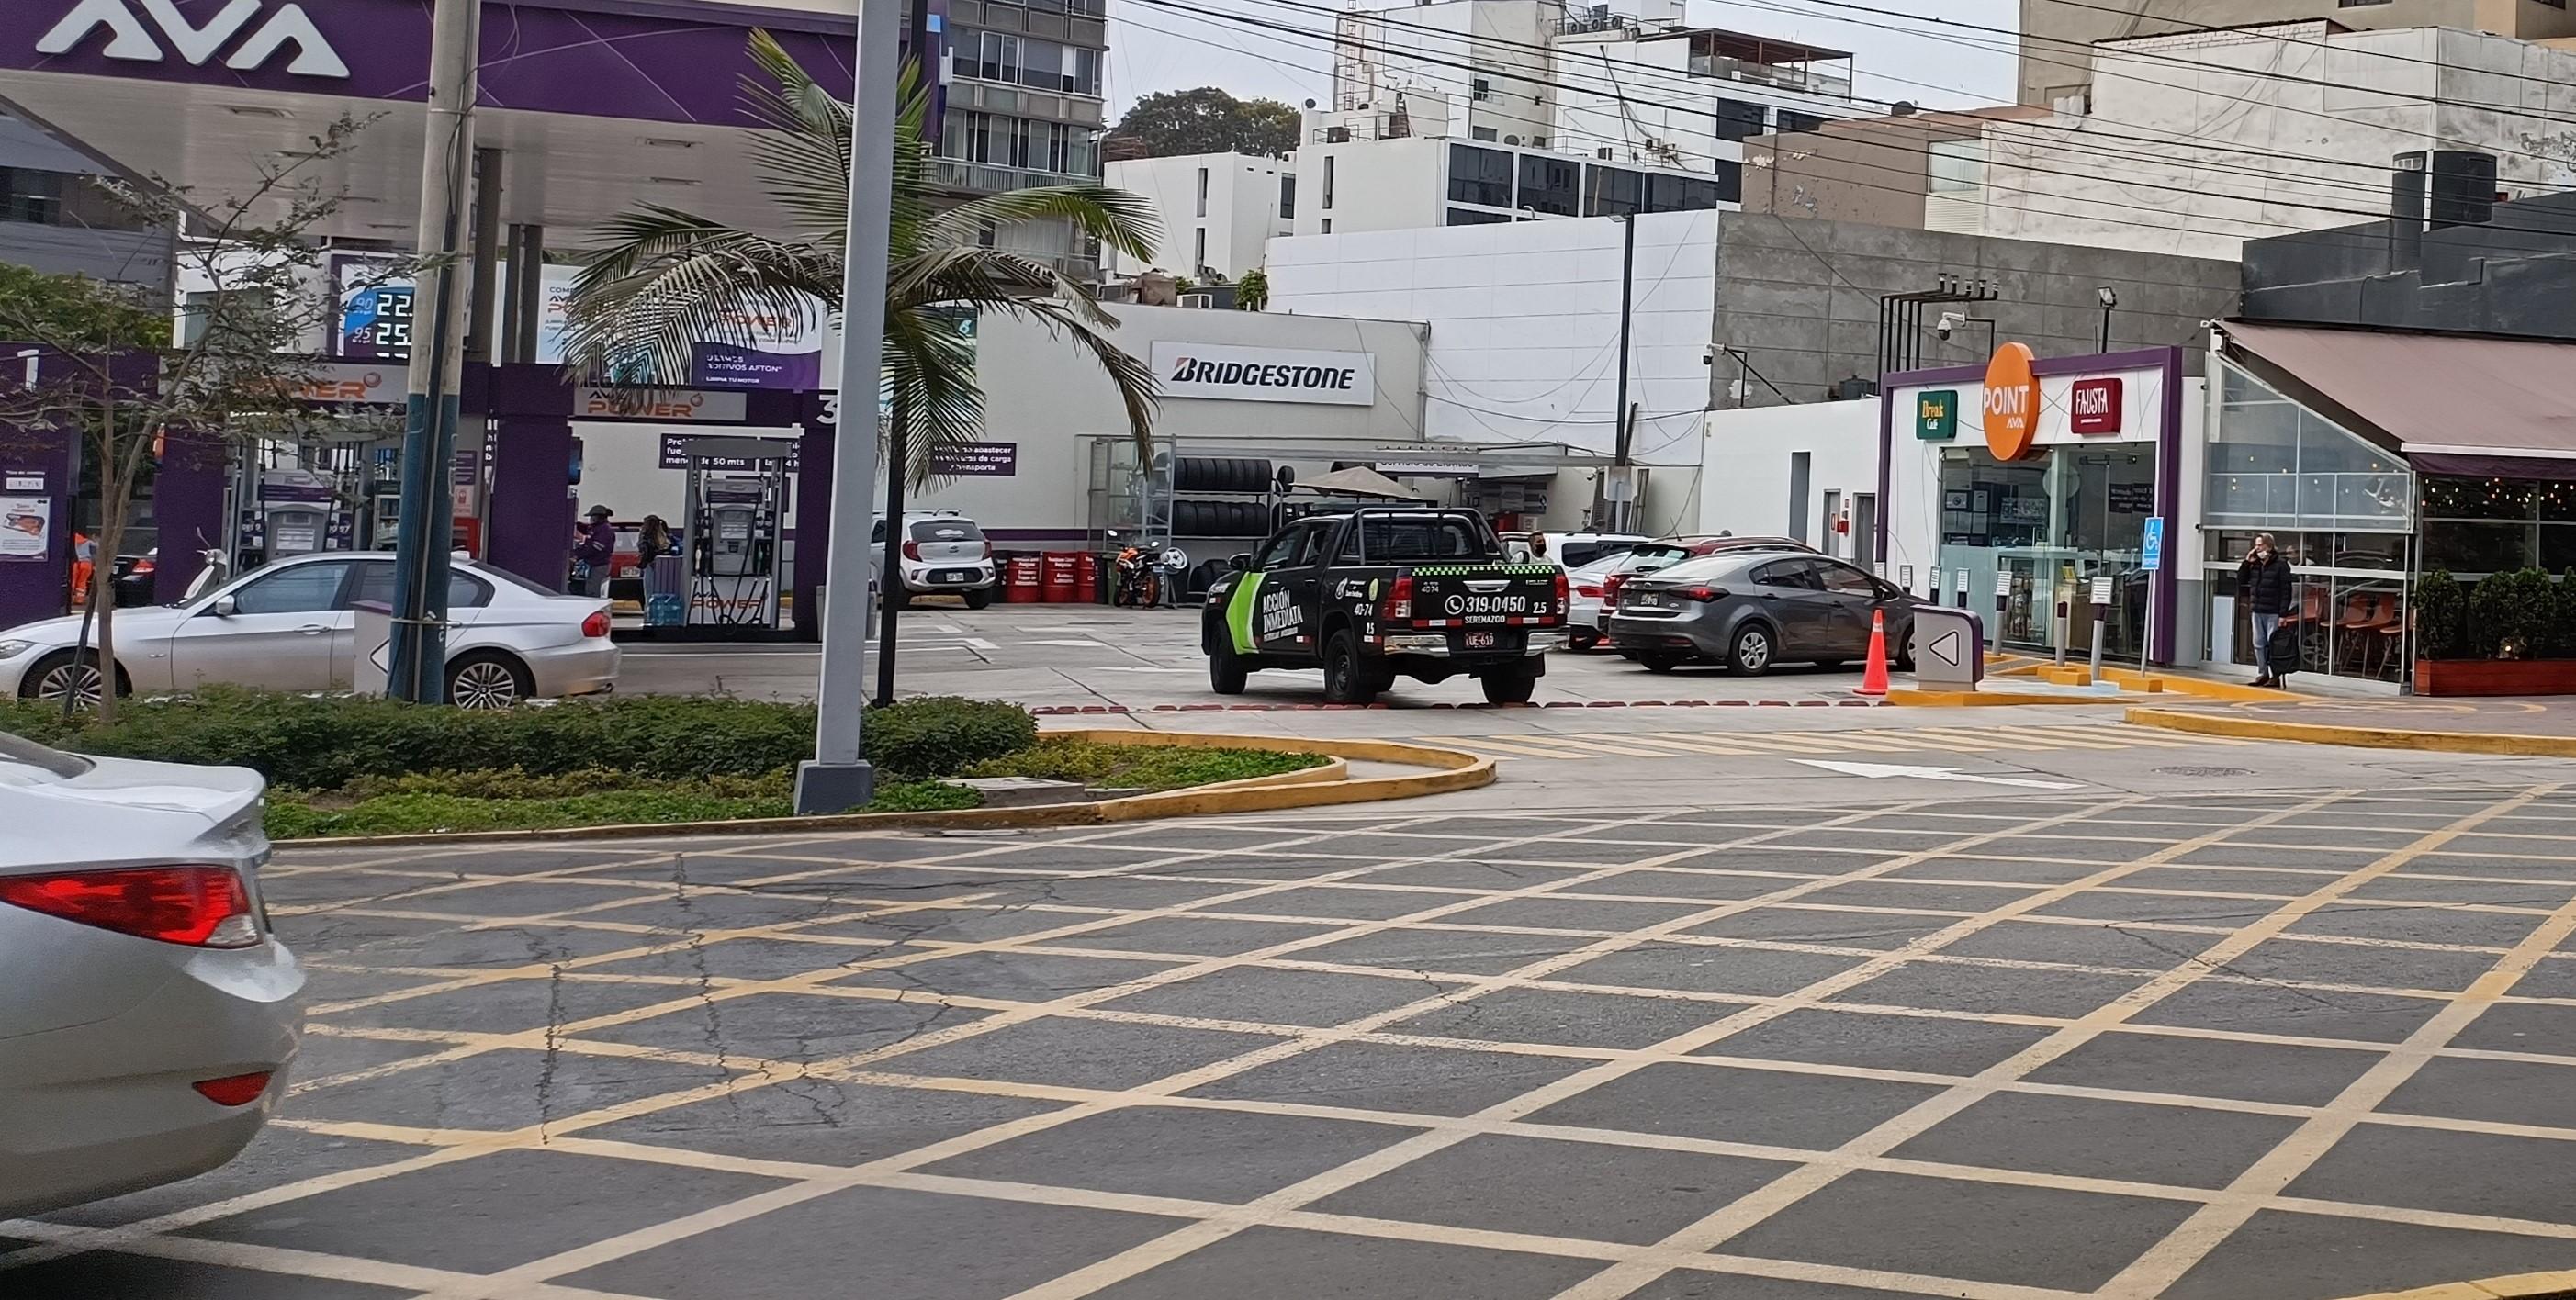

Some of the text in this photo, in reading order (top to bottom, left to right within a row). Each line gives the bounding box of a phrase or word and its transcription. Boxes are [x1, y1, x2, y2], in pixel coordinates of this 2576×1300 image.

[36, 0, 350, 78] AVA
[354, 327, 372, 340] 95
[1171, 357, 1355, 389] BRIDGESTONE
[816, 394, 838, 423] 3
[1983, 385, 2029, 415] POINT
[2075, 387, 2109, 414] FAUSTA
[2006, 417, 2024, 429] AVA
[1263, 587, 1290, 613] ACCIÓN
[1354, 603, 1374, 616] 40-74
[1466, 596, 1526, 613] 319-0450
[1533, 602, 1547, 613] 2.5
[1264, 605, 1303, 633] INMEDIATA
[1465, 615, 1506, 623] SERENAZGO
